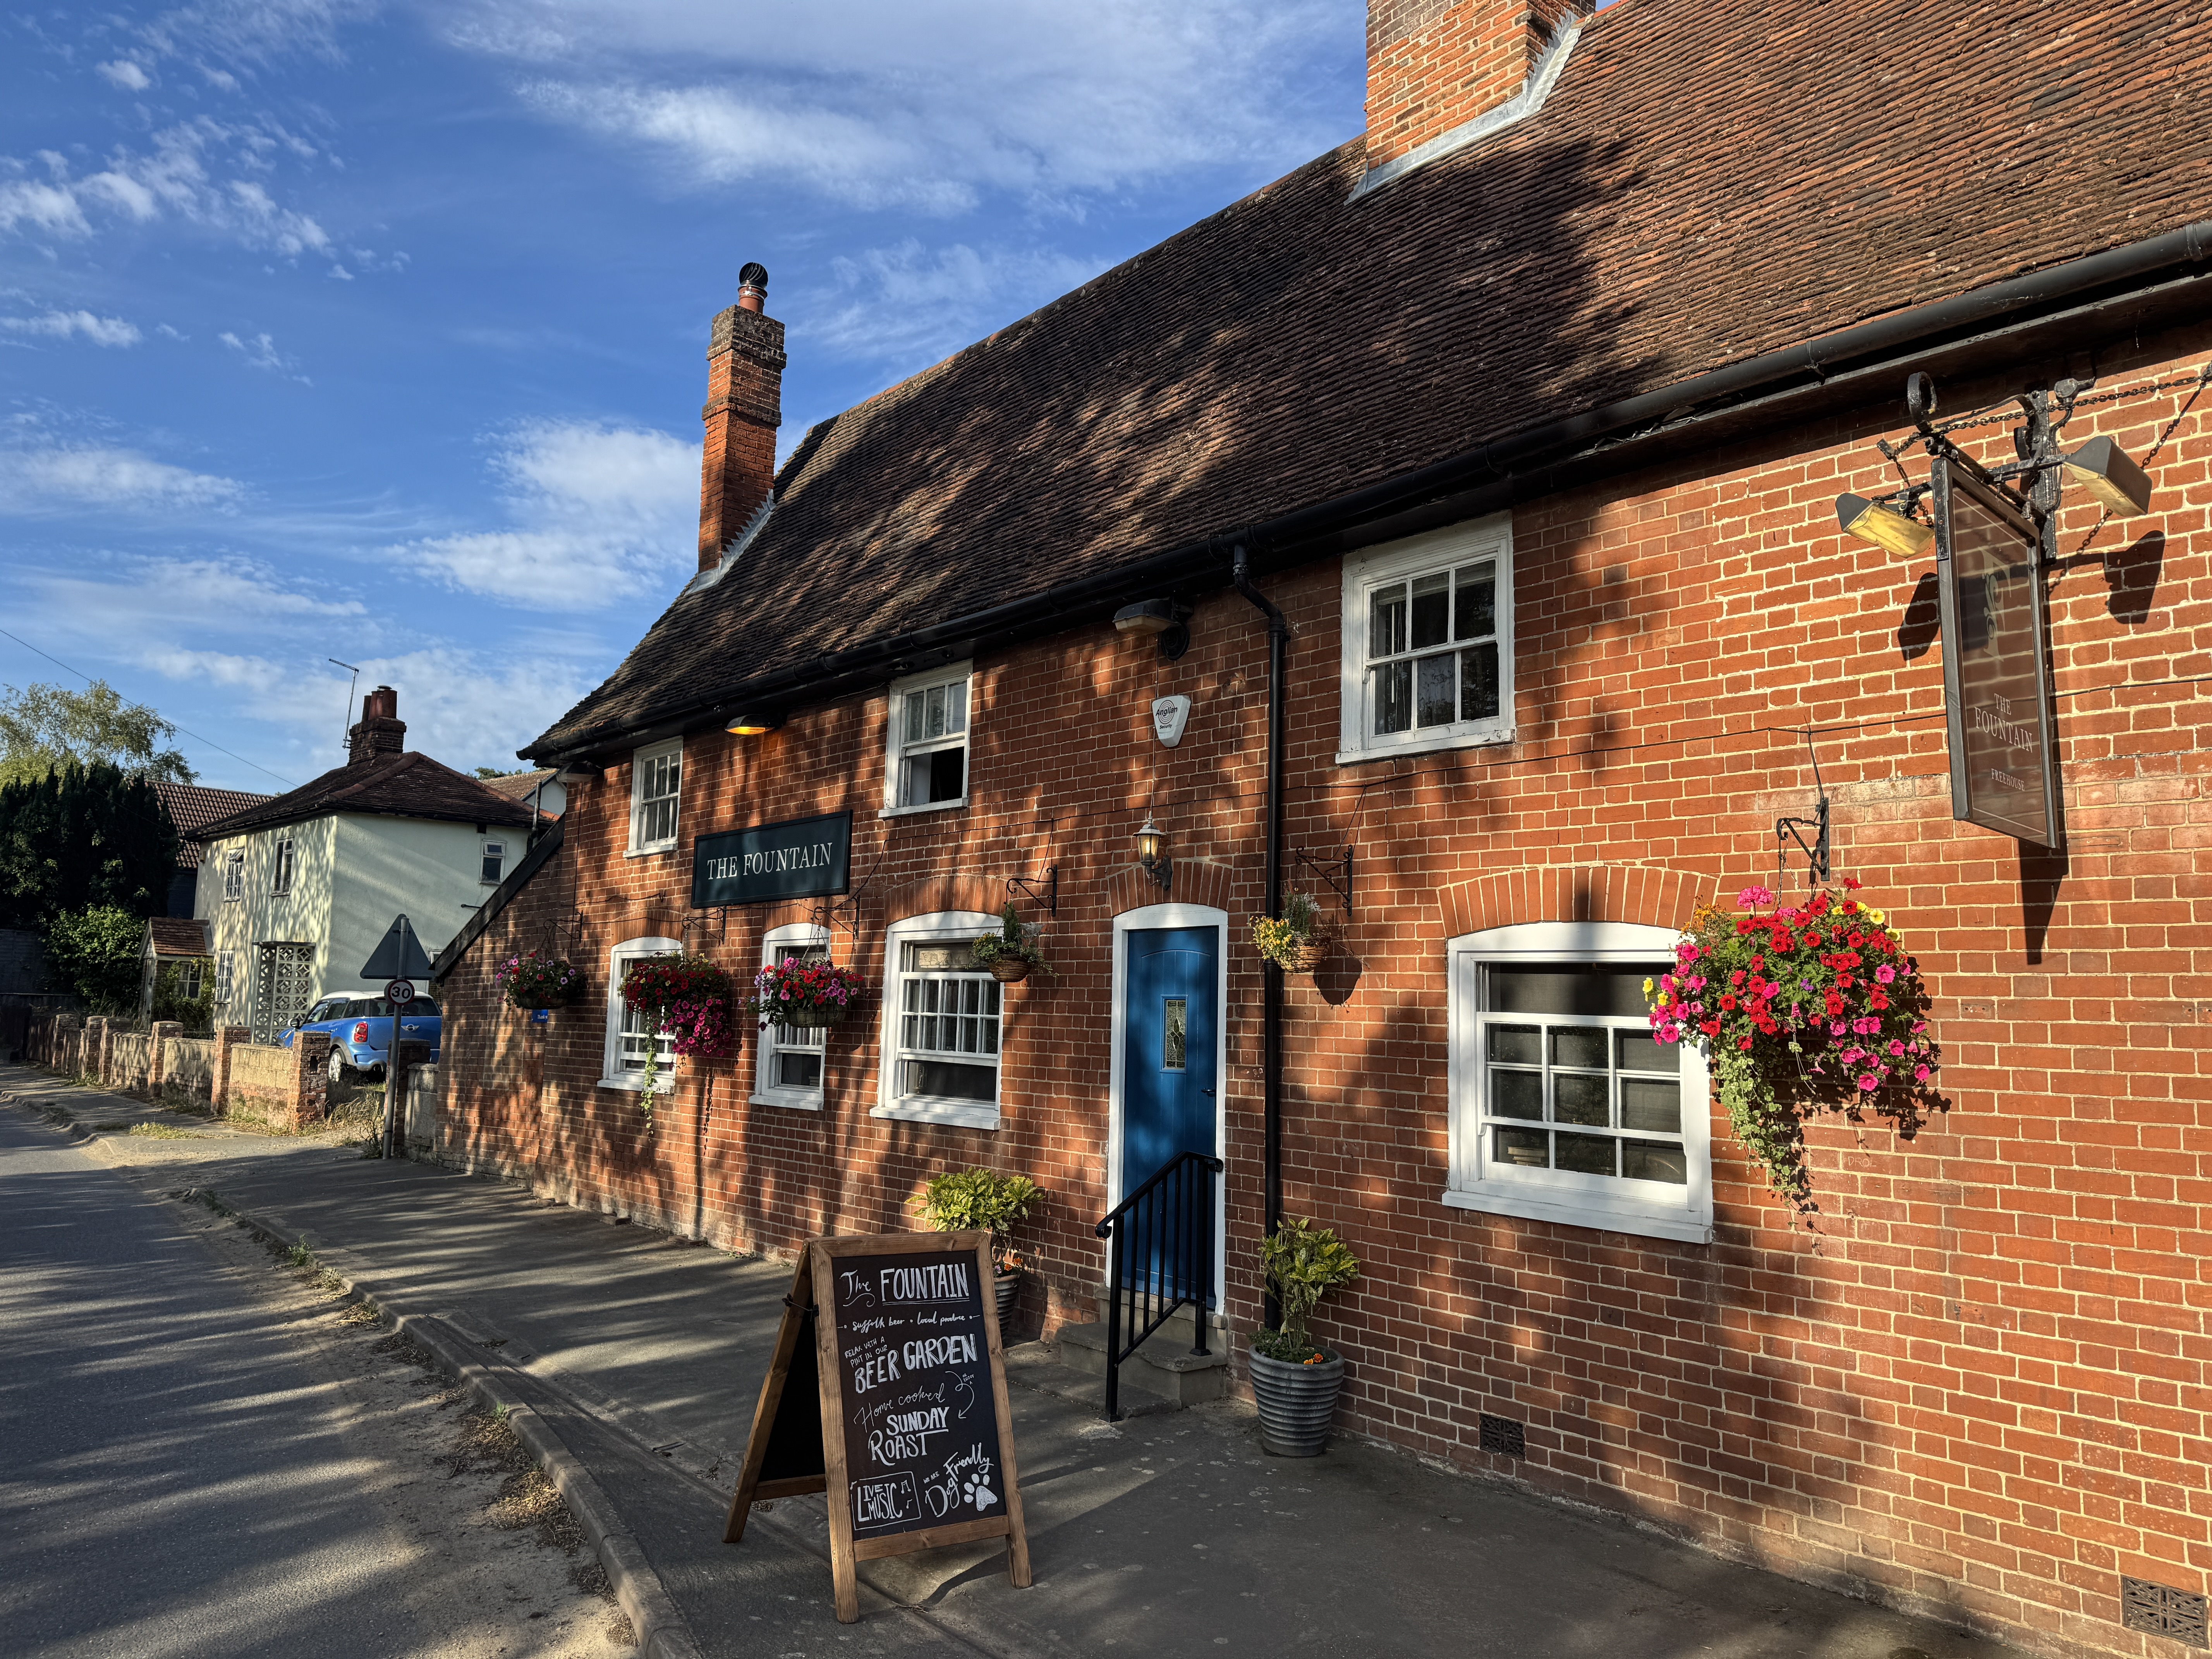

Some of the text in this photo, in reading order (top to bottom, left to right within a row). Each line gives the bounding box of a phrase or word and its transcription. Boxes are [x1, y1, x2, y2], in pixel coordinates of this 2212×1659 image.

[1156, 707, 1178, 716] Anglian
[1994, 693, 2011, 715] THE
[1975, 707, 2032, 753] FOUNTAIN
[1991, 768, 2025, 791] FREEHOUSE
[707, 842, 833, 879] THE FOUNTAIN
[392, 986, 410, 999] 30
[840, 1263, 969, 1302] The FOUNTAIN
[853, 1317, 885, 1333] suffolk
[889, 1317, 905, 1326] beer
[917, 1311, 937, 1325] local
[845, 1345, 863, 1358] RELAX
[850, 1345, 888, 1368] PINT IN OUR
[855, 1333, 978, 1393] BEER GARDEN
[854, 1383, 946, 1433] Home cooked
[886, 1407, 950, 1436] SUNDAY
[868, 1430, 949, 1466] ROAST
[925, 1442, 994, 1517] Dog Friendly
[931, 1471, 939, 1480] ARE
[857, 1484, 883, 1522] LIVE
[867, 1482, 903, 1520] MUSIC
